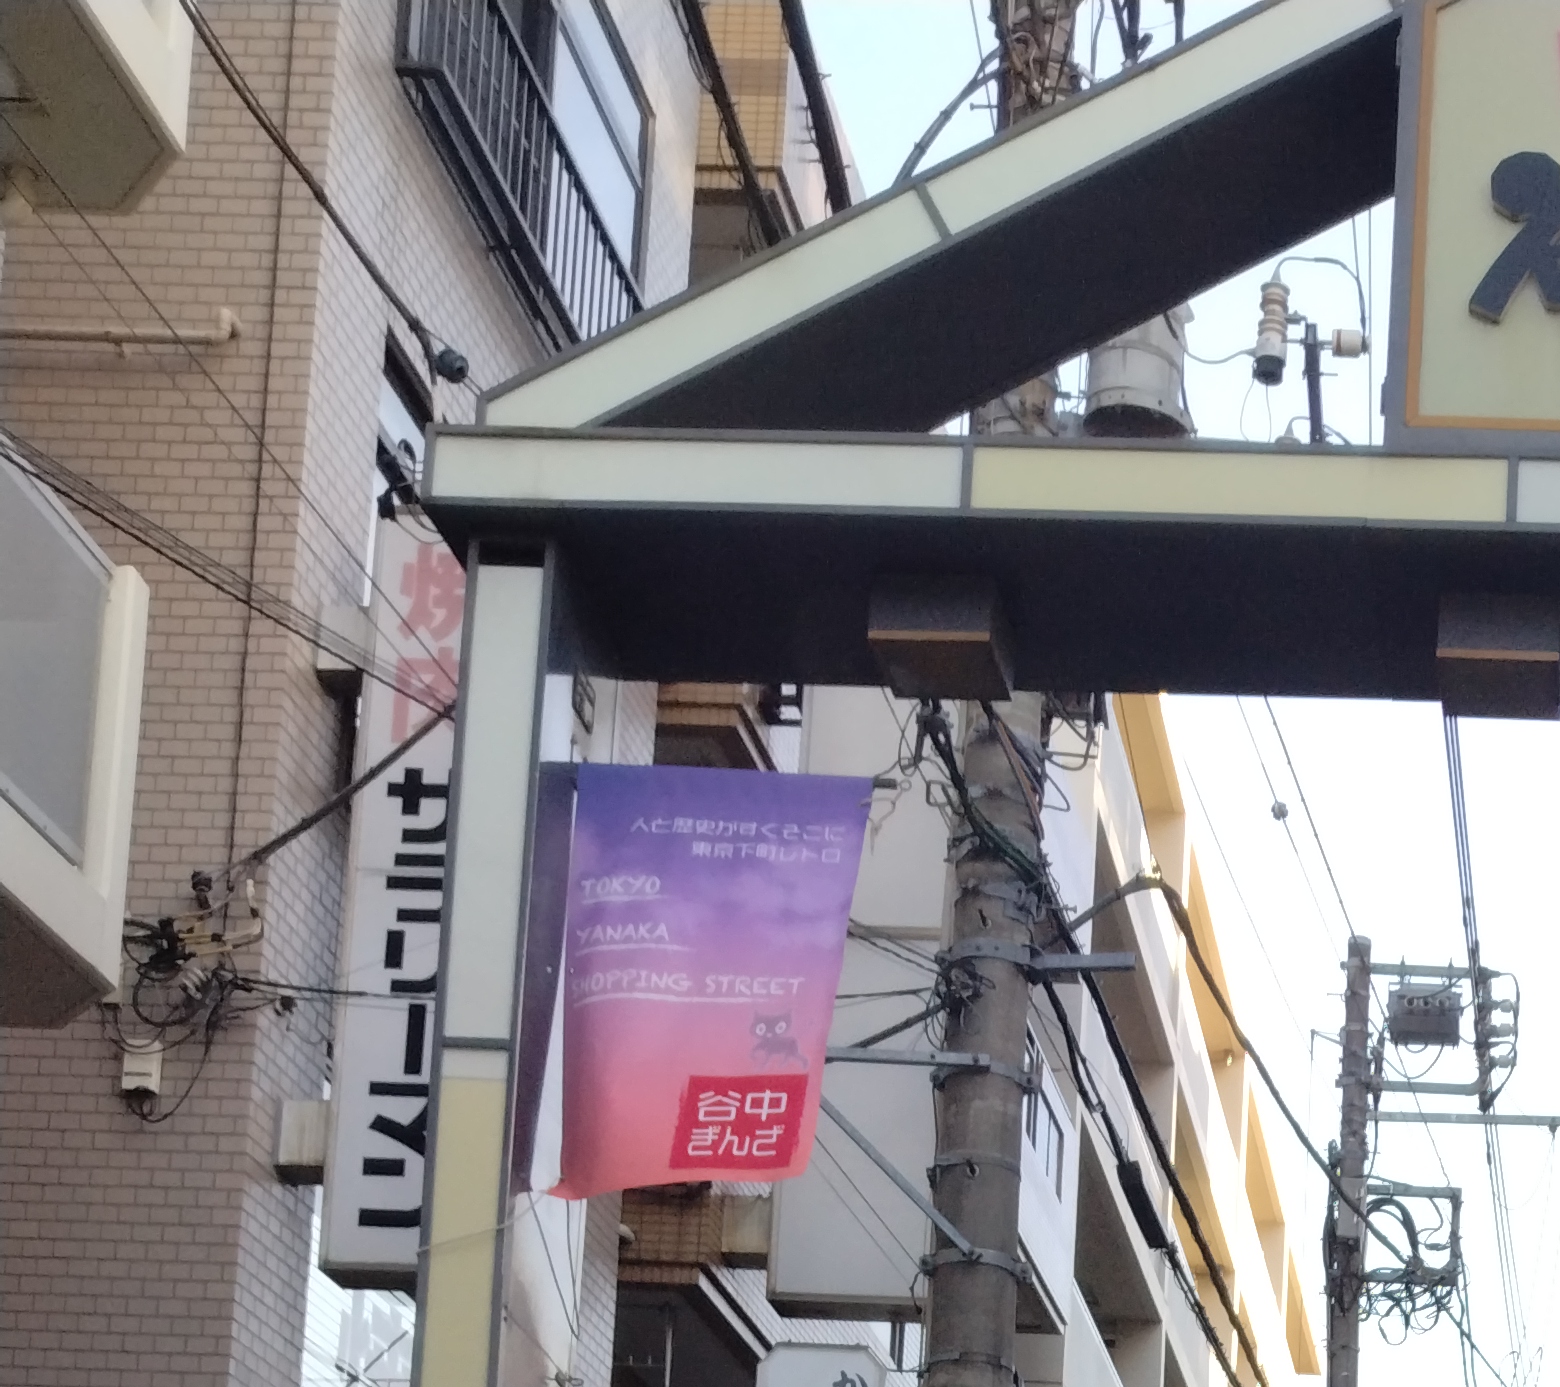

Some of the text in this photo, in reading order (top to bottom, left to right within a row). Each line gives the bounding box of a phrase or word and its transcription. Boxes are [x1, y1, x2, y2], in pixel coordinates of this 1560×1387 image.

[689, 841, 842, 865] 東京下町レトロ
[580, 874, 662, 896] TOKYO
[574, 922, 671, 946] YANAKA
[571, 967, 806, 998] SHOPPING STREET
[696, 1089, 789, 1122] 谷中
[686, 1124, 786, 1157] ぎんざ
